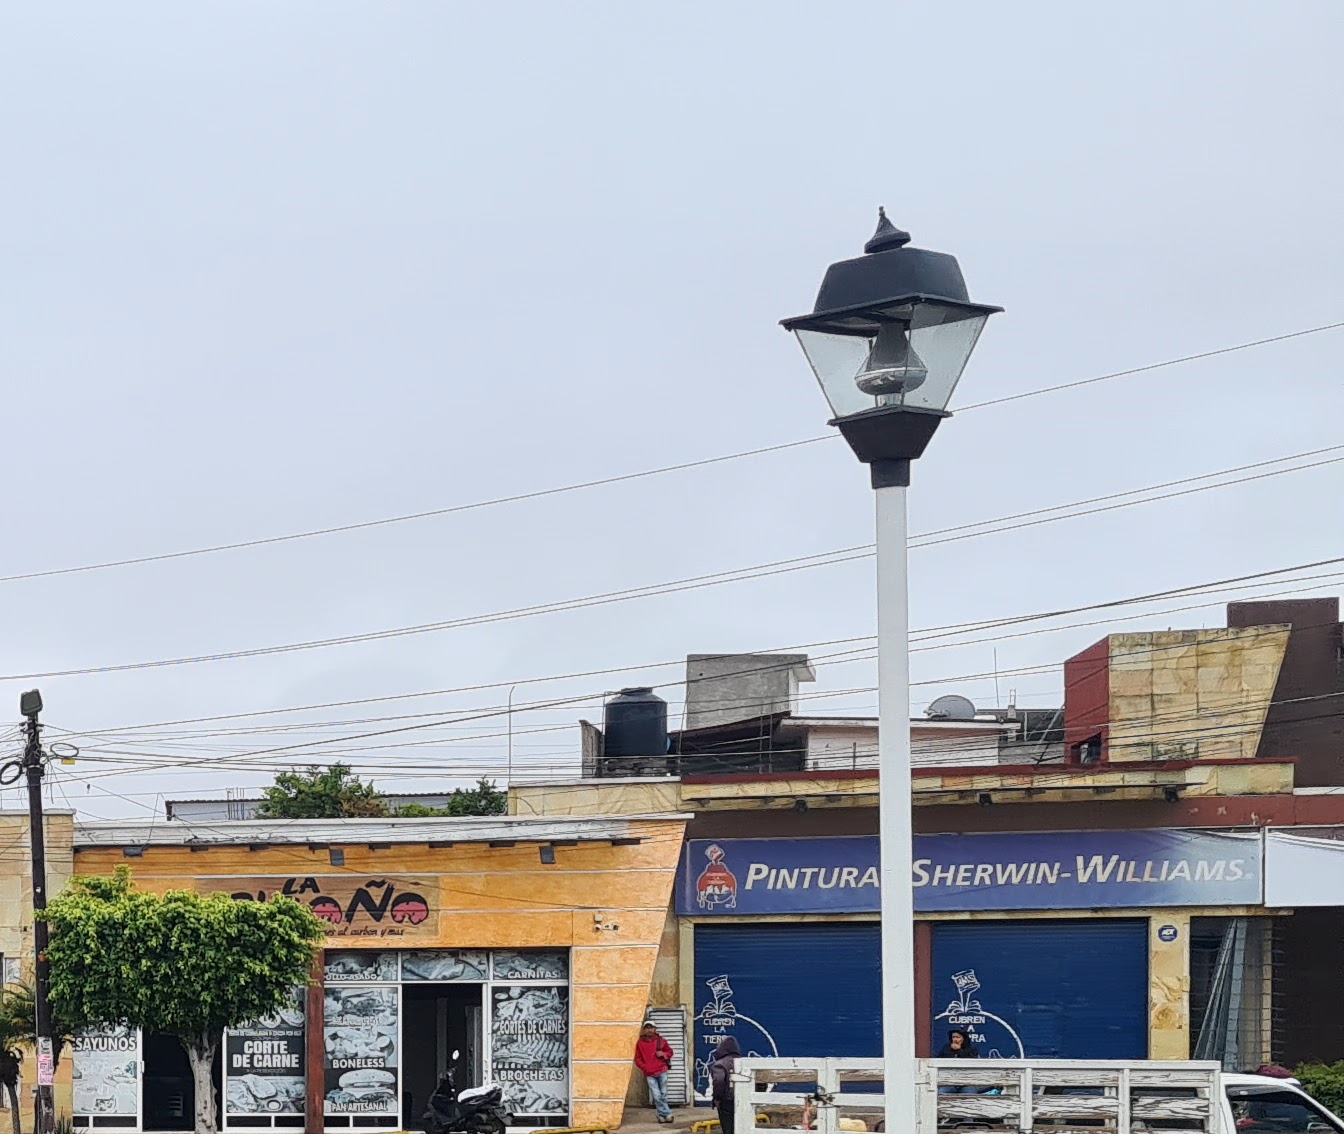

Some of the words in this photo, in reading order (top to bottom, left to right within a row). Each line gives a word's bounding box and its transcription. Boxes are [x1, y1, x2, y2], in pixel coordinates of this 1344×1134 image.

[744, 862, 880, 890] PINTURA
[912, 854, 1245, 888] SHERWIN-WILLIAMS
[282, 877, 321, 896] LA
[324, 973, 347, 981] OLLO
[507, 969, 558, 979] CARNITAS
[500, 1019, 526, 1034] CORTES
[527, 1019, 537, 1034] DE
[538, 1019, 566, 1034] CARNES
[72, 1036, 137, 1051] SAYUNOS
[244, 1040, 289, 1054] CORTE
[233, 1054, 251, 1068] DE
[253, 1054, 300, 1068] CARNE
[332, 1058, 385, 1069] BONELESS
[500, 1070, 565, 1081] BROCHETAS
